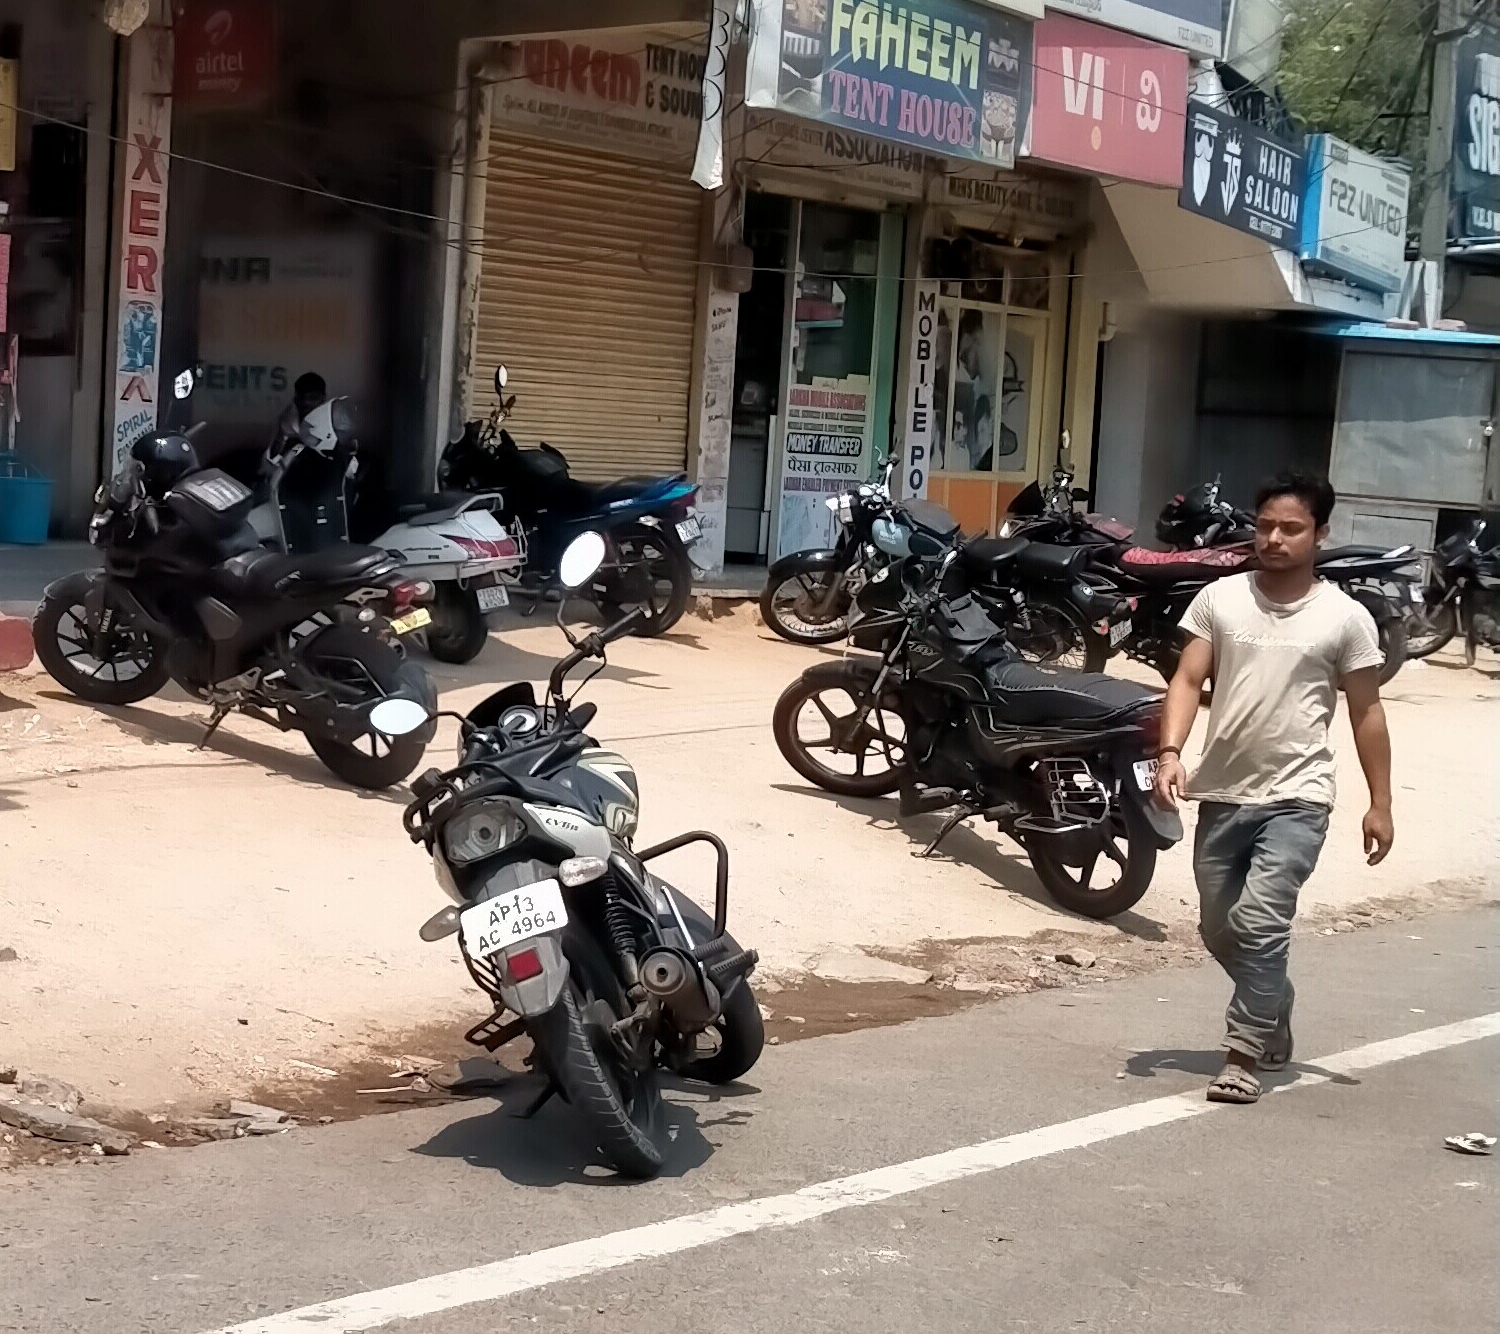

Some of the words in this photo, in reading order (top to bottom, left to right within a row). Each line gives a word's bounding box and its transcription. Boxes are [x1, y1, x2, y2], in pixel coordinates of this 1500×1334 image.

[195, 51, 244, 74] airtel
[827, 68, 895, 128] TENT
[899, 88, 977, 150] HOUSE
[1258, 143, 1292, 186] HAIR
[1244, 174, 1300, 224] SALOON
[1359, 189, 1402, 238] UNITED
[912, 290, 936, 434] MOBILE
[116, 408, 154, 443] SPIRAL
[787, 433, 818, 453] MONEY
[819, 435, 862, 456] TRANSFER
[787, 455, 812, 473] पैसा
[478, 929, 501, 953] AC
[511, 910, 556, 935] 4964
[489, 894, 534, 927] AP13
